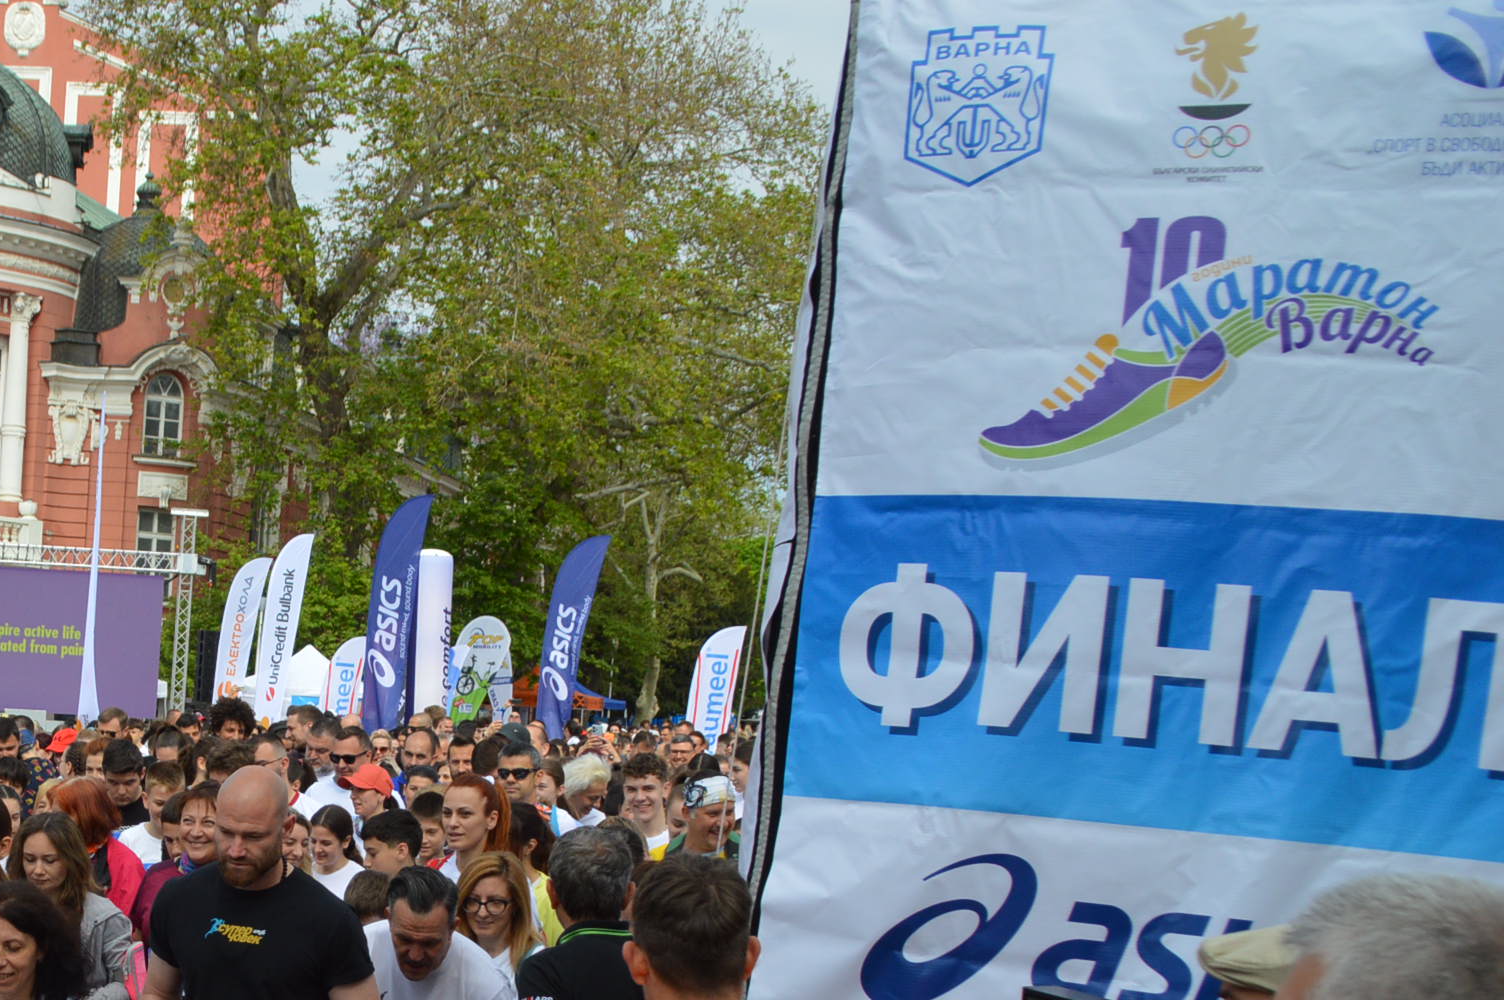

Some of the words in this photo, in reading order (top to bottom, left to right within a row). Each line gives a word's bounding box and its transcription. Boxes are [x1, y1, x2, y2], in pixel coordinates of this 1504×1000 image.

[936, 40, 1033, 60] ВАРНА
[1120, 215, 1228, 328] 10
[1142, 257, 1440, 361] Маратон
[1265, 296, 1435, 367] Варна
[276, 568, 296, 623] Bulbank
[24, 622, 59, 639] active
[62, 624, 81, 640] life
[30, 638, 57, 655] from
[268, 625, 288, 685] UniCredit
[839, 562, 1504, 773] ФИНАЛ
[703, 652, 729, 750] aumeel
